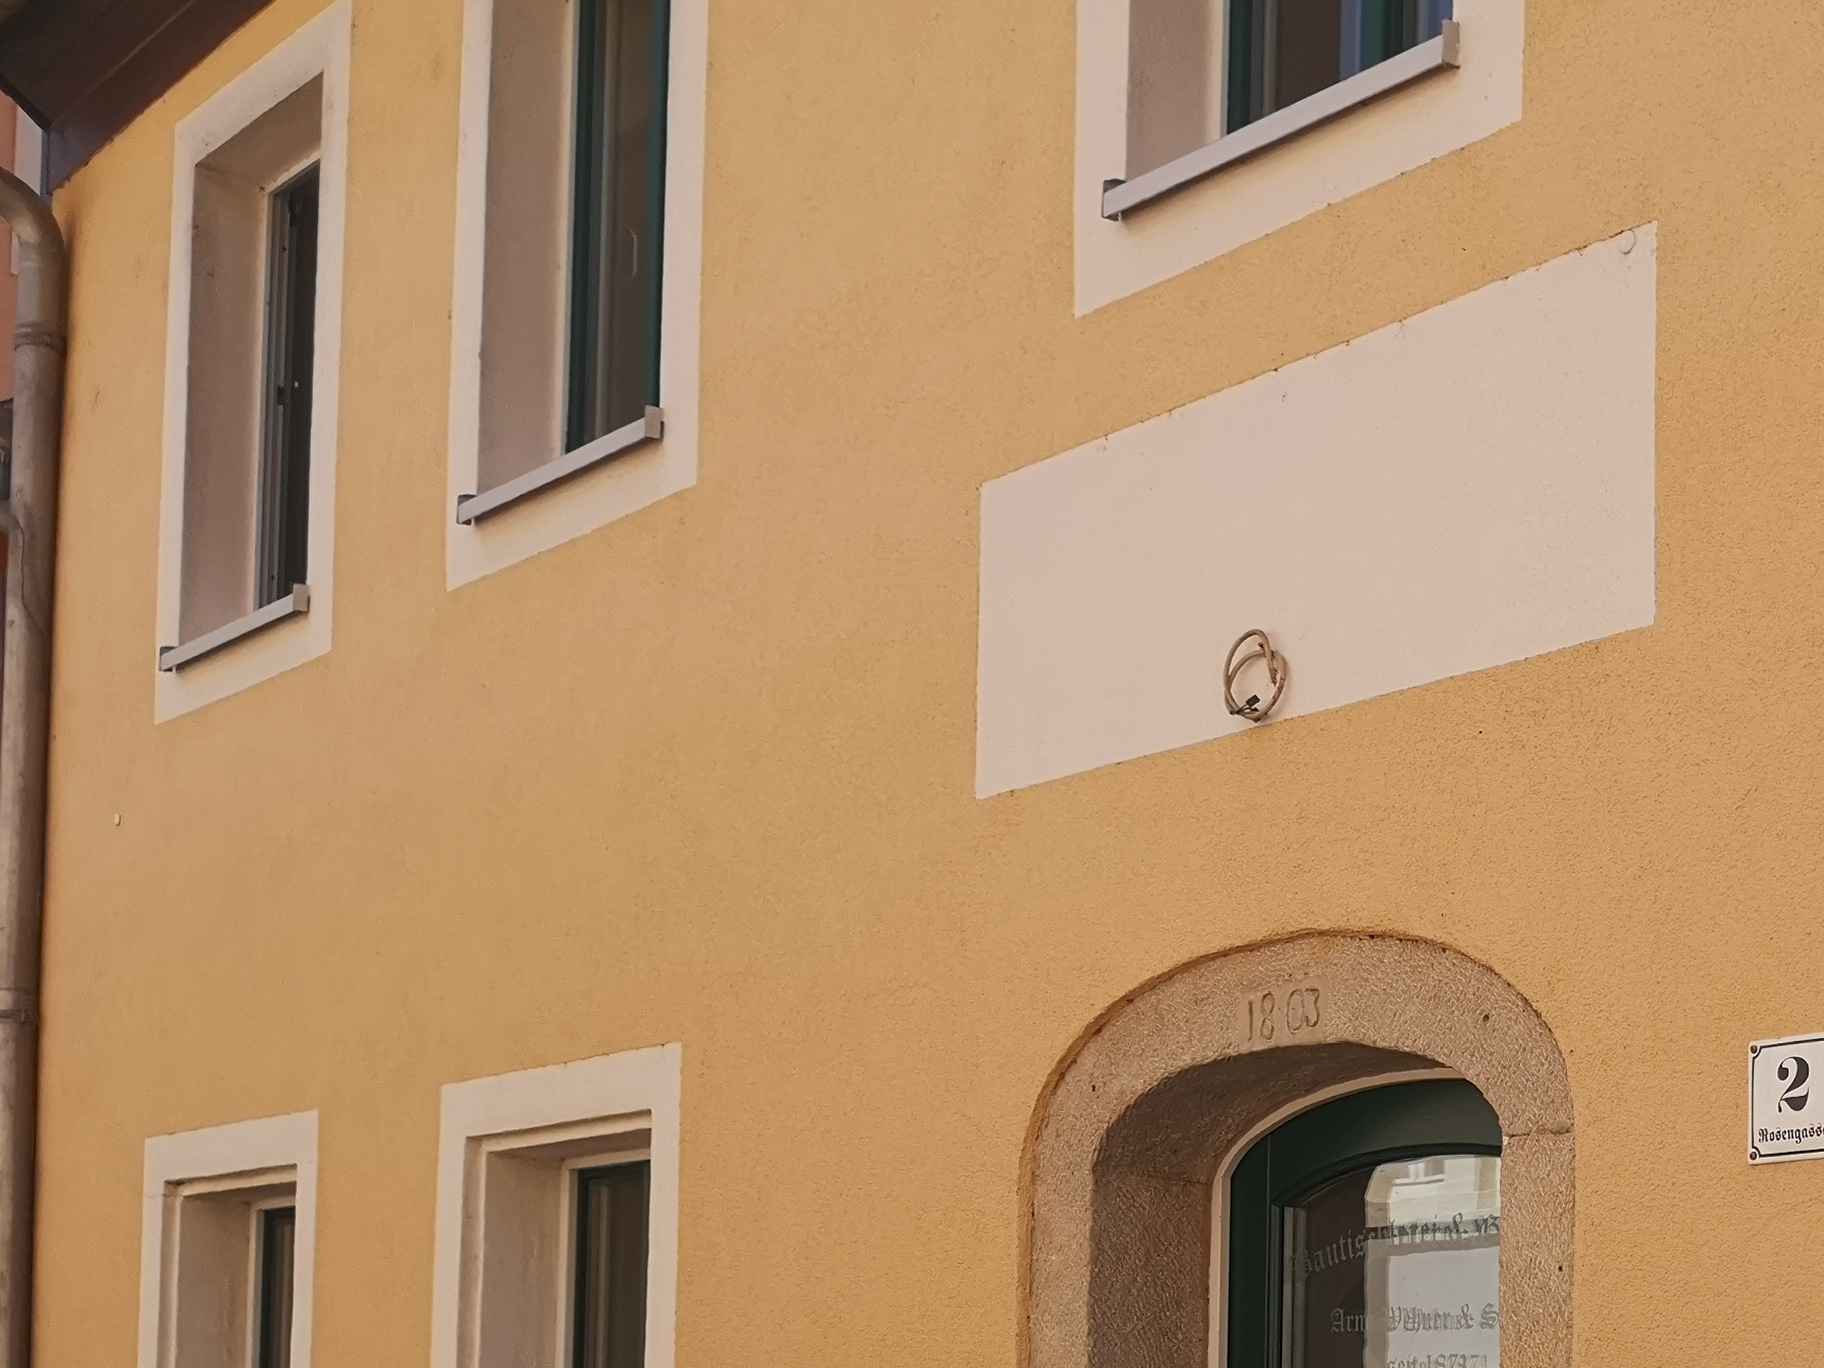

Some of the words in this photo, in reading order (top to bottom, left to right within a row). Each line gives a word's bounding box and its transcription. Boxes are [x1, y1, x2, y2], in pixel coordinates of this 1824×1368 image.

[1776, 1055, 1810, 1114] 2
[1330, 1307, 1366, 1333] Arn
[1479, 1302, 1500, 1330] S
